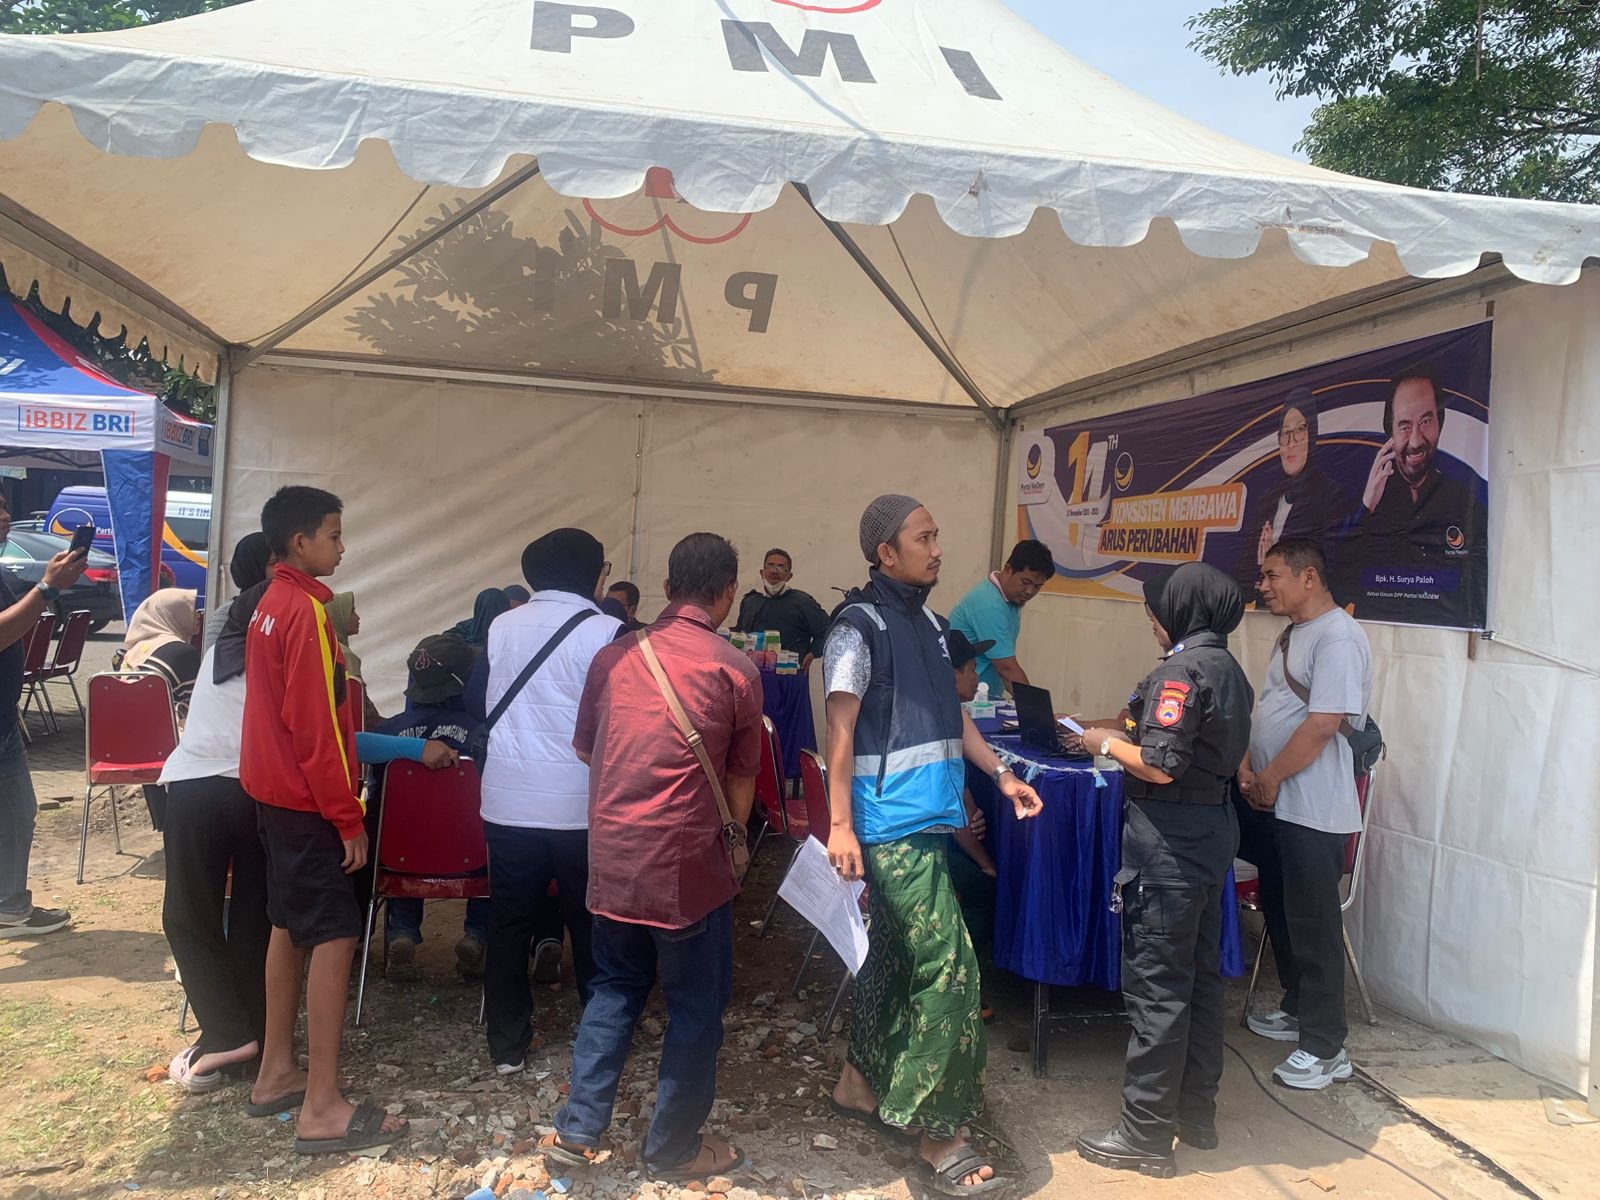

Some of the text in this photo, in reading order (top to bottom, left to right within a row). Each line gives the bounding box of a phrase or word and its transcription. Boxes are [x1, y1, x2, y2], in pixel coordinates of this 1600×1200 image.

[26, 410, 130, 432] iBBIZ BRI
[1112, 491, 1237, 523] KONSISTEN MEMBAWA
[1100, 527, 1199, 553] ARUS PERUBAHAN
[1375, 575, 1389, 583] Bpk.
[1397, 576, 1415, 585] Surya
[1415, 576, 1434, 584] Paloh
